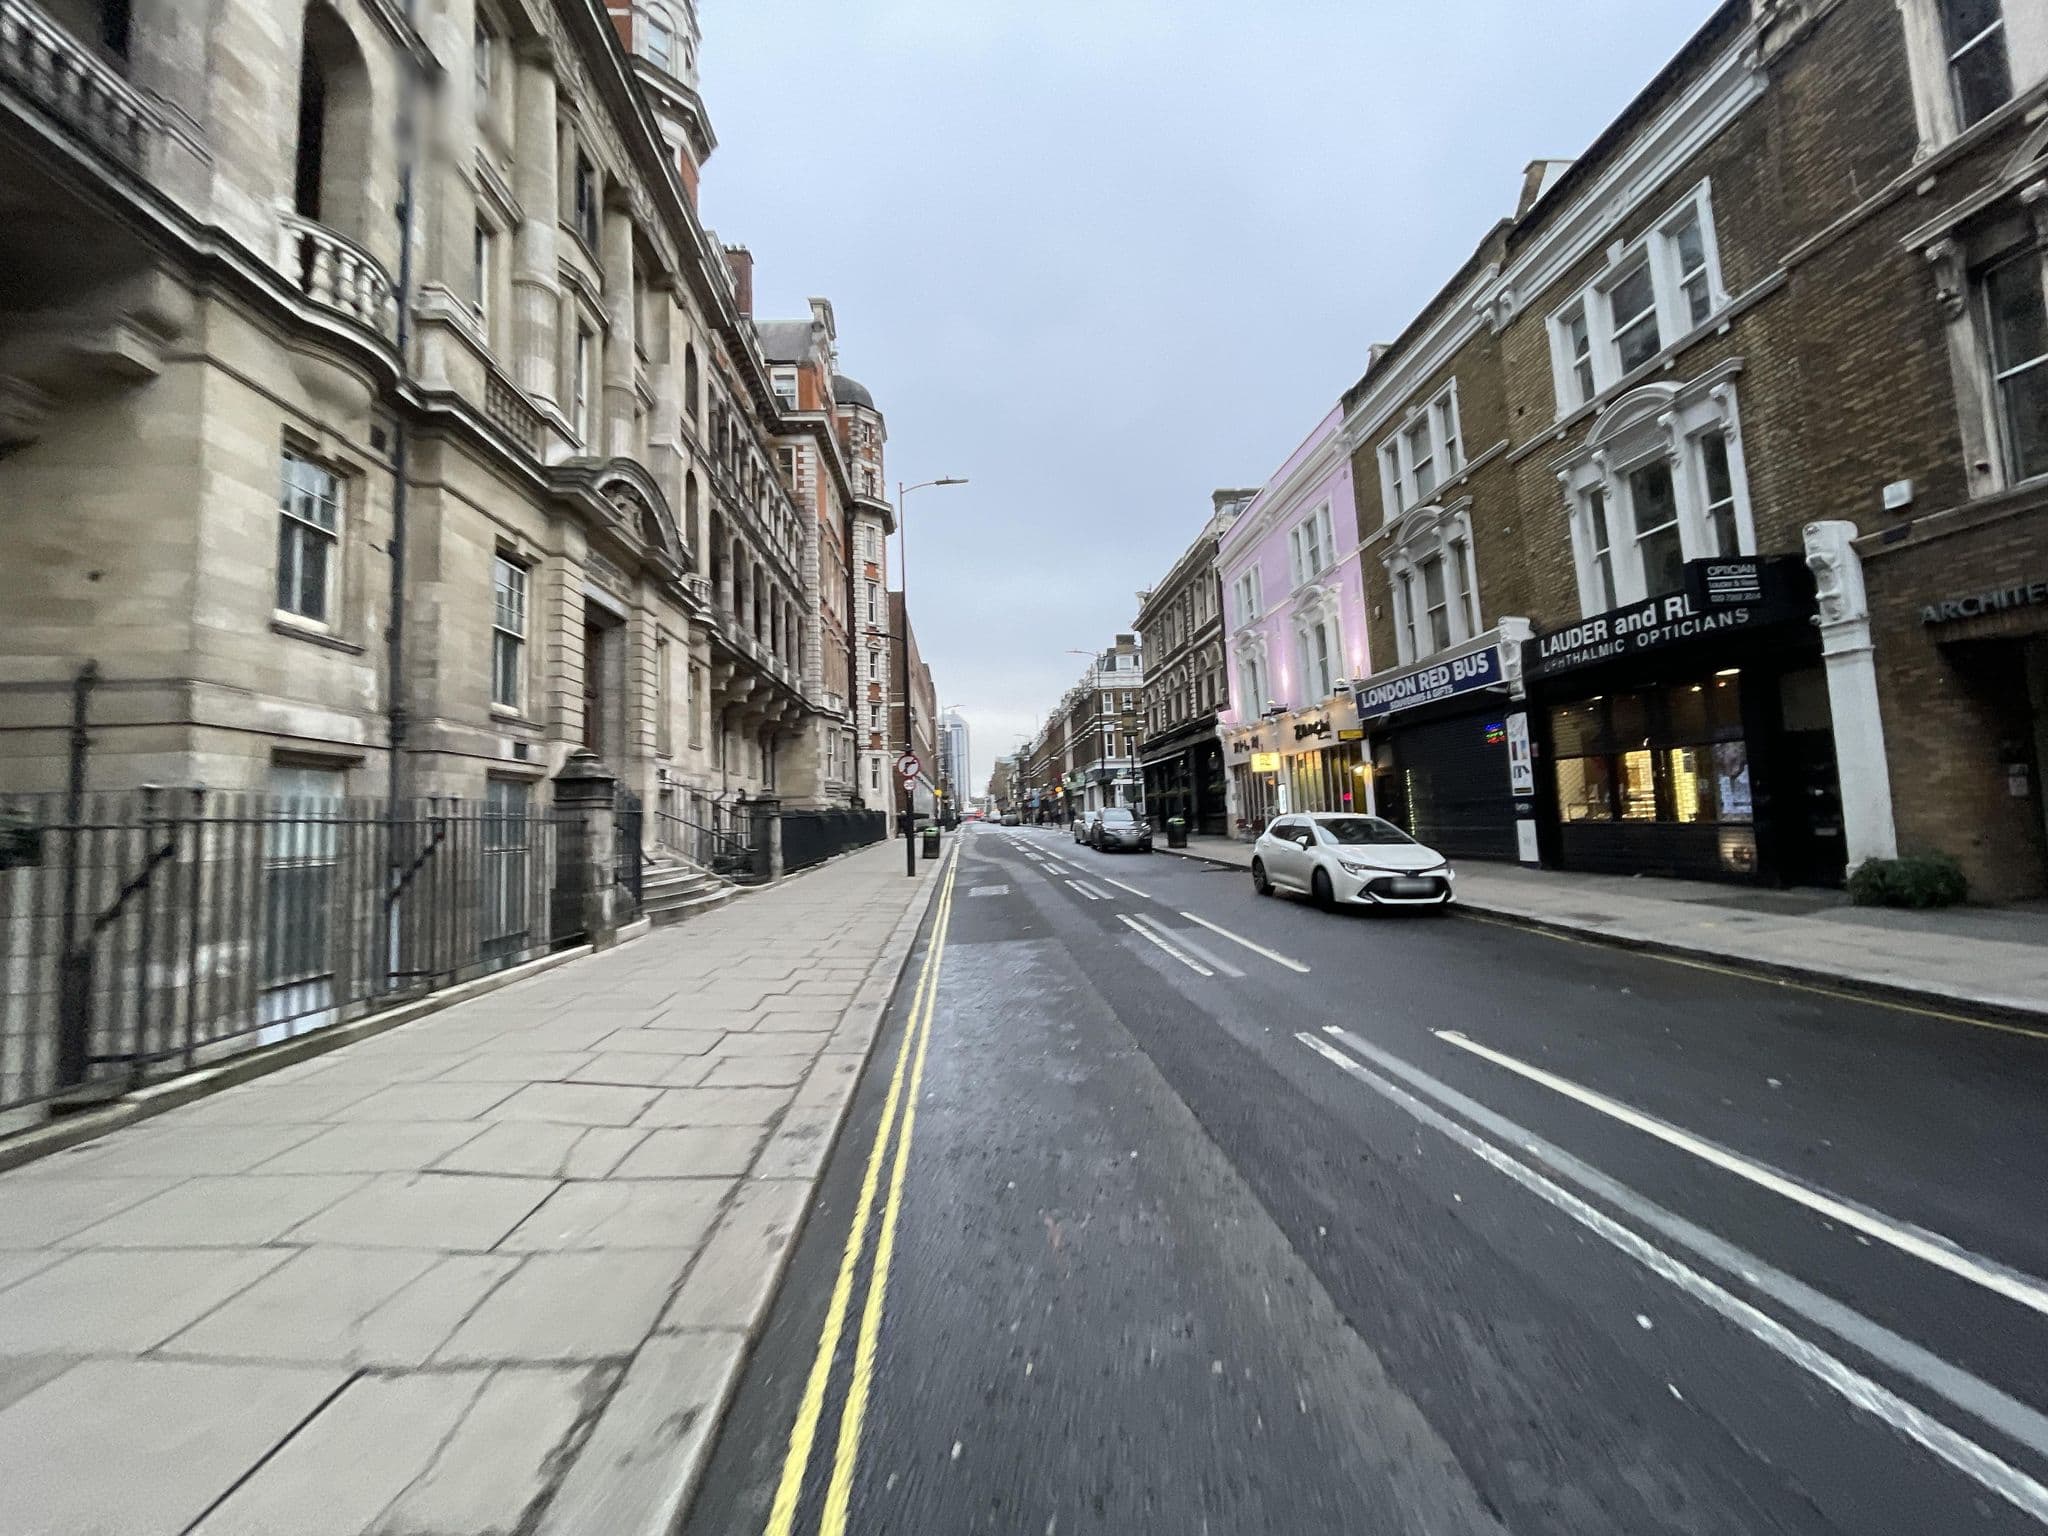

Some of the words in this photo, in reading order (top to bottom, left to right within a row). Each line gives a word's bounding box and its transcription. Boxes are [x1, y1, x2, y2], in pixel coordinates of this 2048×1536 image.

[1707, 564, 1757, 576] OPTICIAN
[1540, 619, 1608, 658] LAUDER
[1615, 603, 1657, 636] and
[1920, 583, 2048, 625] ARCHITE
[1544, 639, 1626, 673] OPHTHALMIC
[1637, 608, 1750, 648] OPTICIANS
[1361, 676, 1418, 709] LONDON
[1418, 667, 1450, 692] RED
[1452, 652, 1490, 681] BUS
